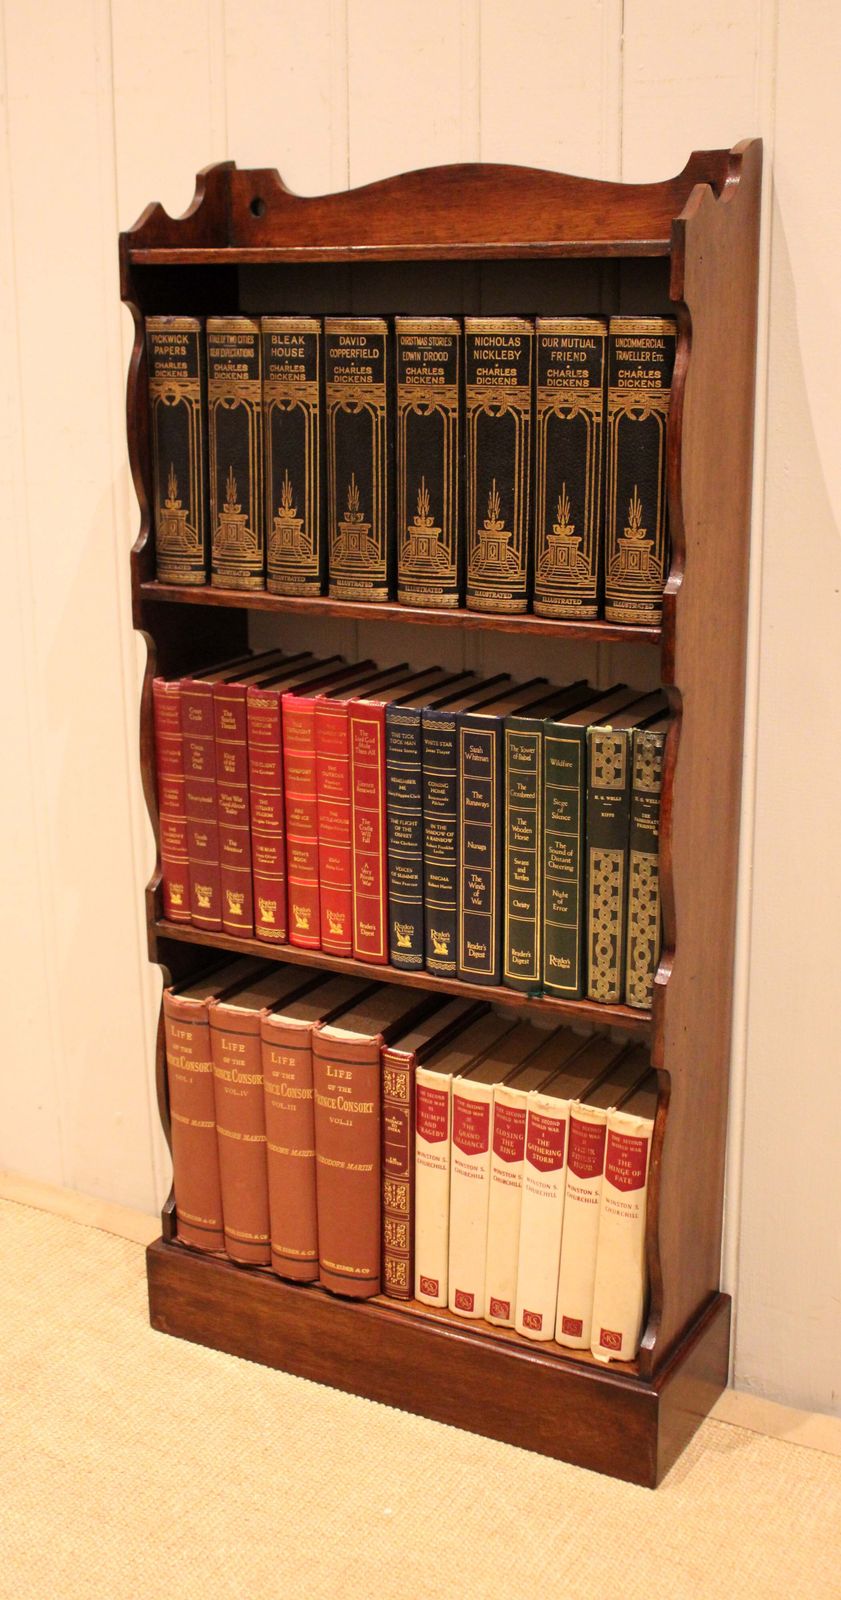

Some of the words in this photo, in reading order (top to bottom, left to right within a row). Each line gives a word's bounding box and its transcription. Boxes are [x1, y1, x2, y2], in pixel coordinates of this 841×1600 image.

[151, 335, 189, 344] PICKWICK
[271, 335, 306, 345] BLEAK
[339, 337, 367, 346] DAVID
[400, 337, 427, 346] CHRISTMAS
[429, 337, 453, 347] STORIES
[474, 337, 521, 347] NICHOLAS
[541, 338, 560, 348] OUR
[561, 338, 597, 348] MUTUAL
[615, 338, 667, 348] UNCOMMERCIAL
[154, 346, 187, 356] PAPERS
[271, 348, 305, 358] HOUSE
[329, 349, 380, 359] COPPERFIELD
[473, 350, 522, 360] NICKLEBY
[616, 351, 651, 361] TRAVELLER
[402, 352, 421, 361] EDWIN
[423, 352, 449, 362] DROOD
[550, 352, 588, 362] FRIEND
[155, 362, 188, 370] CHARLES
[214, 364, 249, 372] CHARLES
[270, 365, 306, 373] CHARLES
[333, 367, 373, 375] CHARLES
[405, 368, 445, 376] CHARLES
[547, 370, 590, 378] CHARLES
[618, 371, 662, 379] CHARLES
[333, 375, 374, 383] DICKENS
[547, 379, 590, 387] DICKENS
[618, 380, 662, 388] DICKENS
[337, 580, 373, 588] ILLUSTRATED
[404, 586, 444, 594] ILLUSTRATED
[474, 591, 513, 599] ILLUSTRATED
[542, 596, 583, 605] ILLUSTRATED
[613, 600, 655, 610] ILLUSTRATED
[550, 758, 574, 768] Wildfire
[471, 790, 483, 799] The
[552, 798, 568, 807] Siege
[551, 812, 571, 821] Silence
[511, 824, 533, 834] Wooden
[554, 841, 567, 849] The
[471, 874, 483, 882] The
[552, 903, 568, 912] Error
[466, 941, 487, 951] Reader's
[468, 949, 486, 959] Digest
[511, 948, 531, 958] Reader's
[512, 956, 530, 965] Digest
[171, 1025, 193, 1041] LIFE
[221, 1038, 246, 1053] LIFE
[271, 1052, 296, 1066] LIFE
[281, 1072, 296, 1080] THE
[326, 1065, 352, 1080] LIFE
[338, 1086, 353, 1094] THE
[337, 1096, 374, 1113] CONSORT
[496, 1128, 525, 1140] CLOSING
[502, 1138, 515, 1147] THE
[537, 1138, 551, 1147] THE
[528, 1144, 562, 1157] GATHERING
[532, 1153, 554, 1164] STORM
[618, 1159, 633, 1168] THE
[455, 1159, 478, 1171] WINSTON
[494, 1167, 517, 1180] WINSTON
[608, 1163, 630, 1176] HINGE
[631, 1170, 642, 1178] OF
[614, 1174, 633, 1185] FATE
[568, 1184, 593, 1196] WINSTON
[605, 1197, 632, 1209] WINSTON
